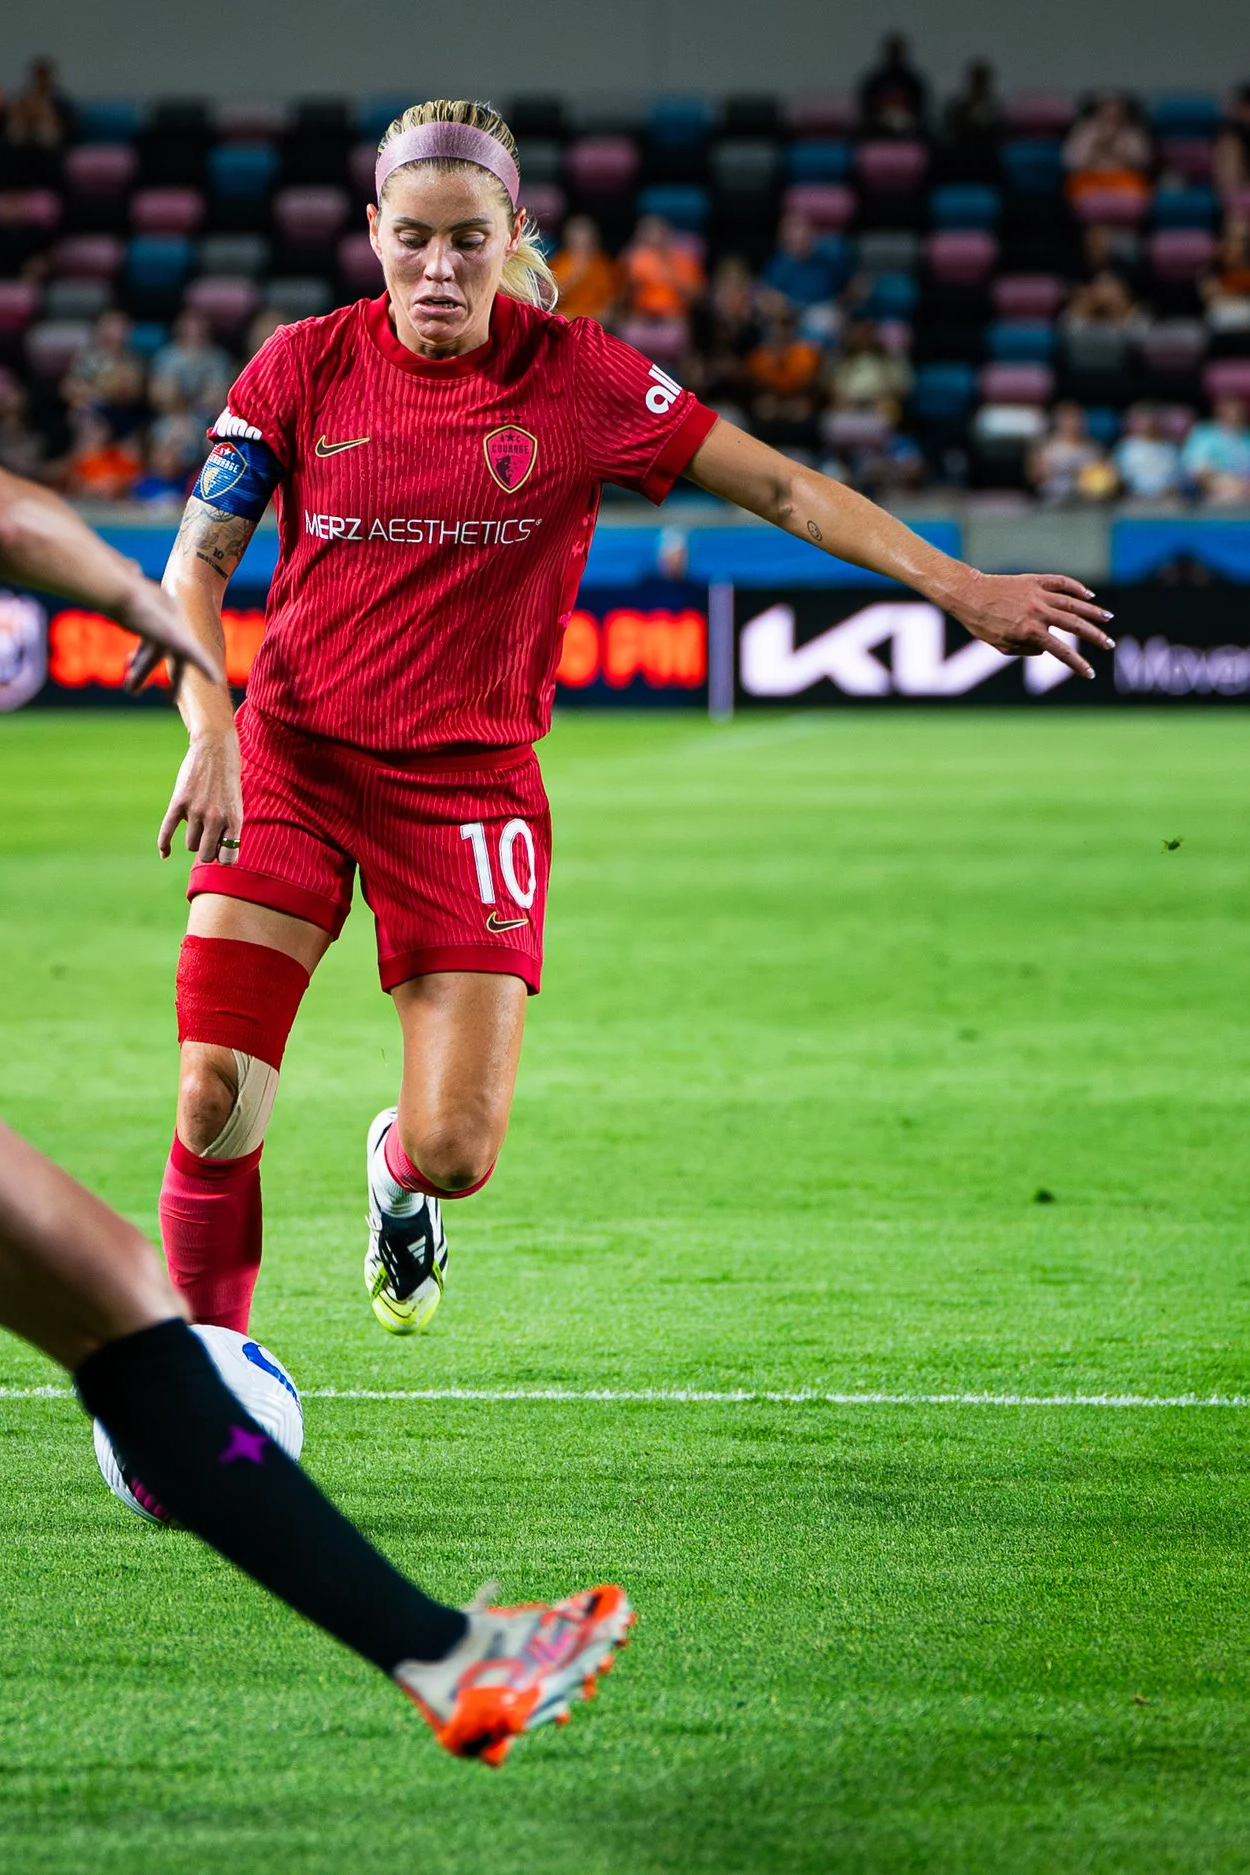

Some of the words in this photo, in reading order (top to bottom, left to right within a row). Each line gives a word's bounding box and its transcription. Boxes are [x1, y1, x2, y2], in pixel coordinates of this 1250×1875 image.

[491, 443, 529, 454] COURAGE
[305, 509, 363, 541] MERZ
[1114, 633, 1250, 695] Move
[459, 817, 537, 910] 10
